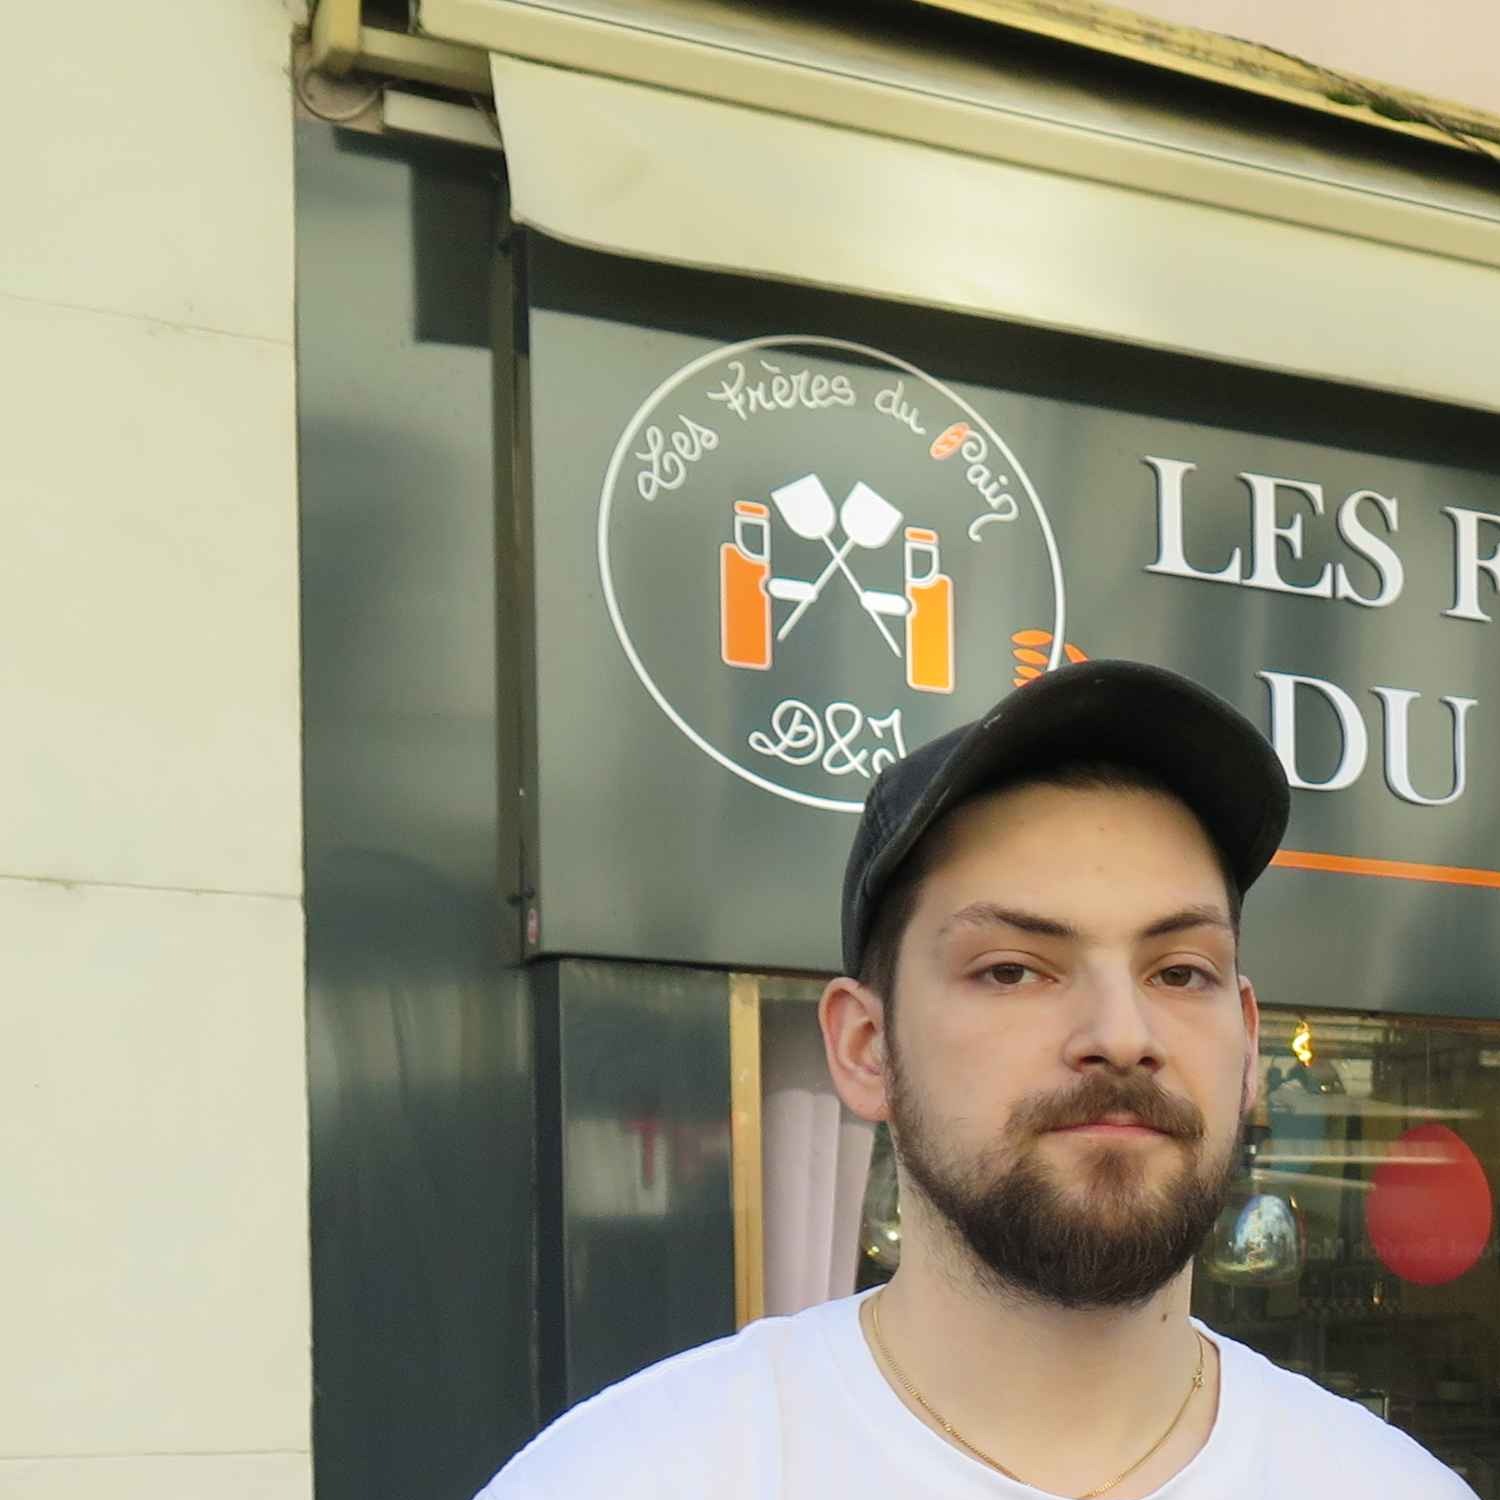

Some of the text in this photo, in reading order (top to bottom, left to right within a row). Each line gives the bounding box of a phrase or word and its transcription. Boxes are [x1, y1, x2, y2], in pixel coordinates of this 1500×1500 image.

[637, 415, 719, 501] Les
[707, 360, 855, 420] Frères
[875, 381, 926, 436] du
[1142, 454, 1404, 609] LES
[1256, 669, 1478, 808] DU
